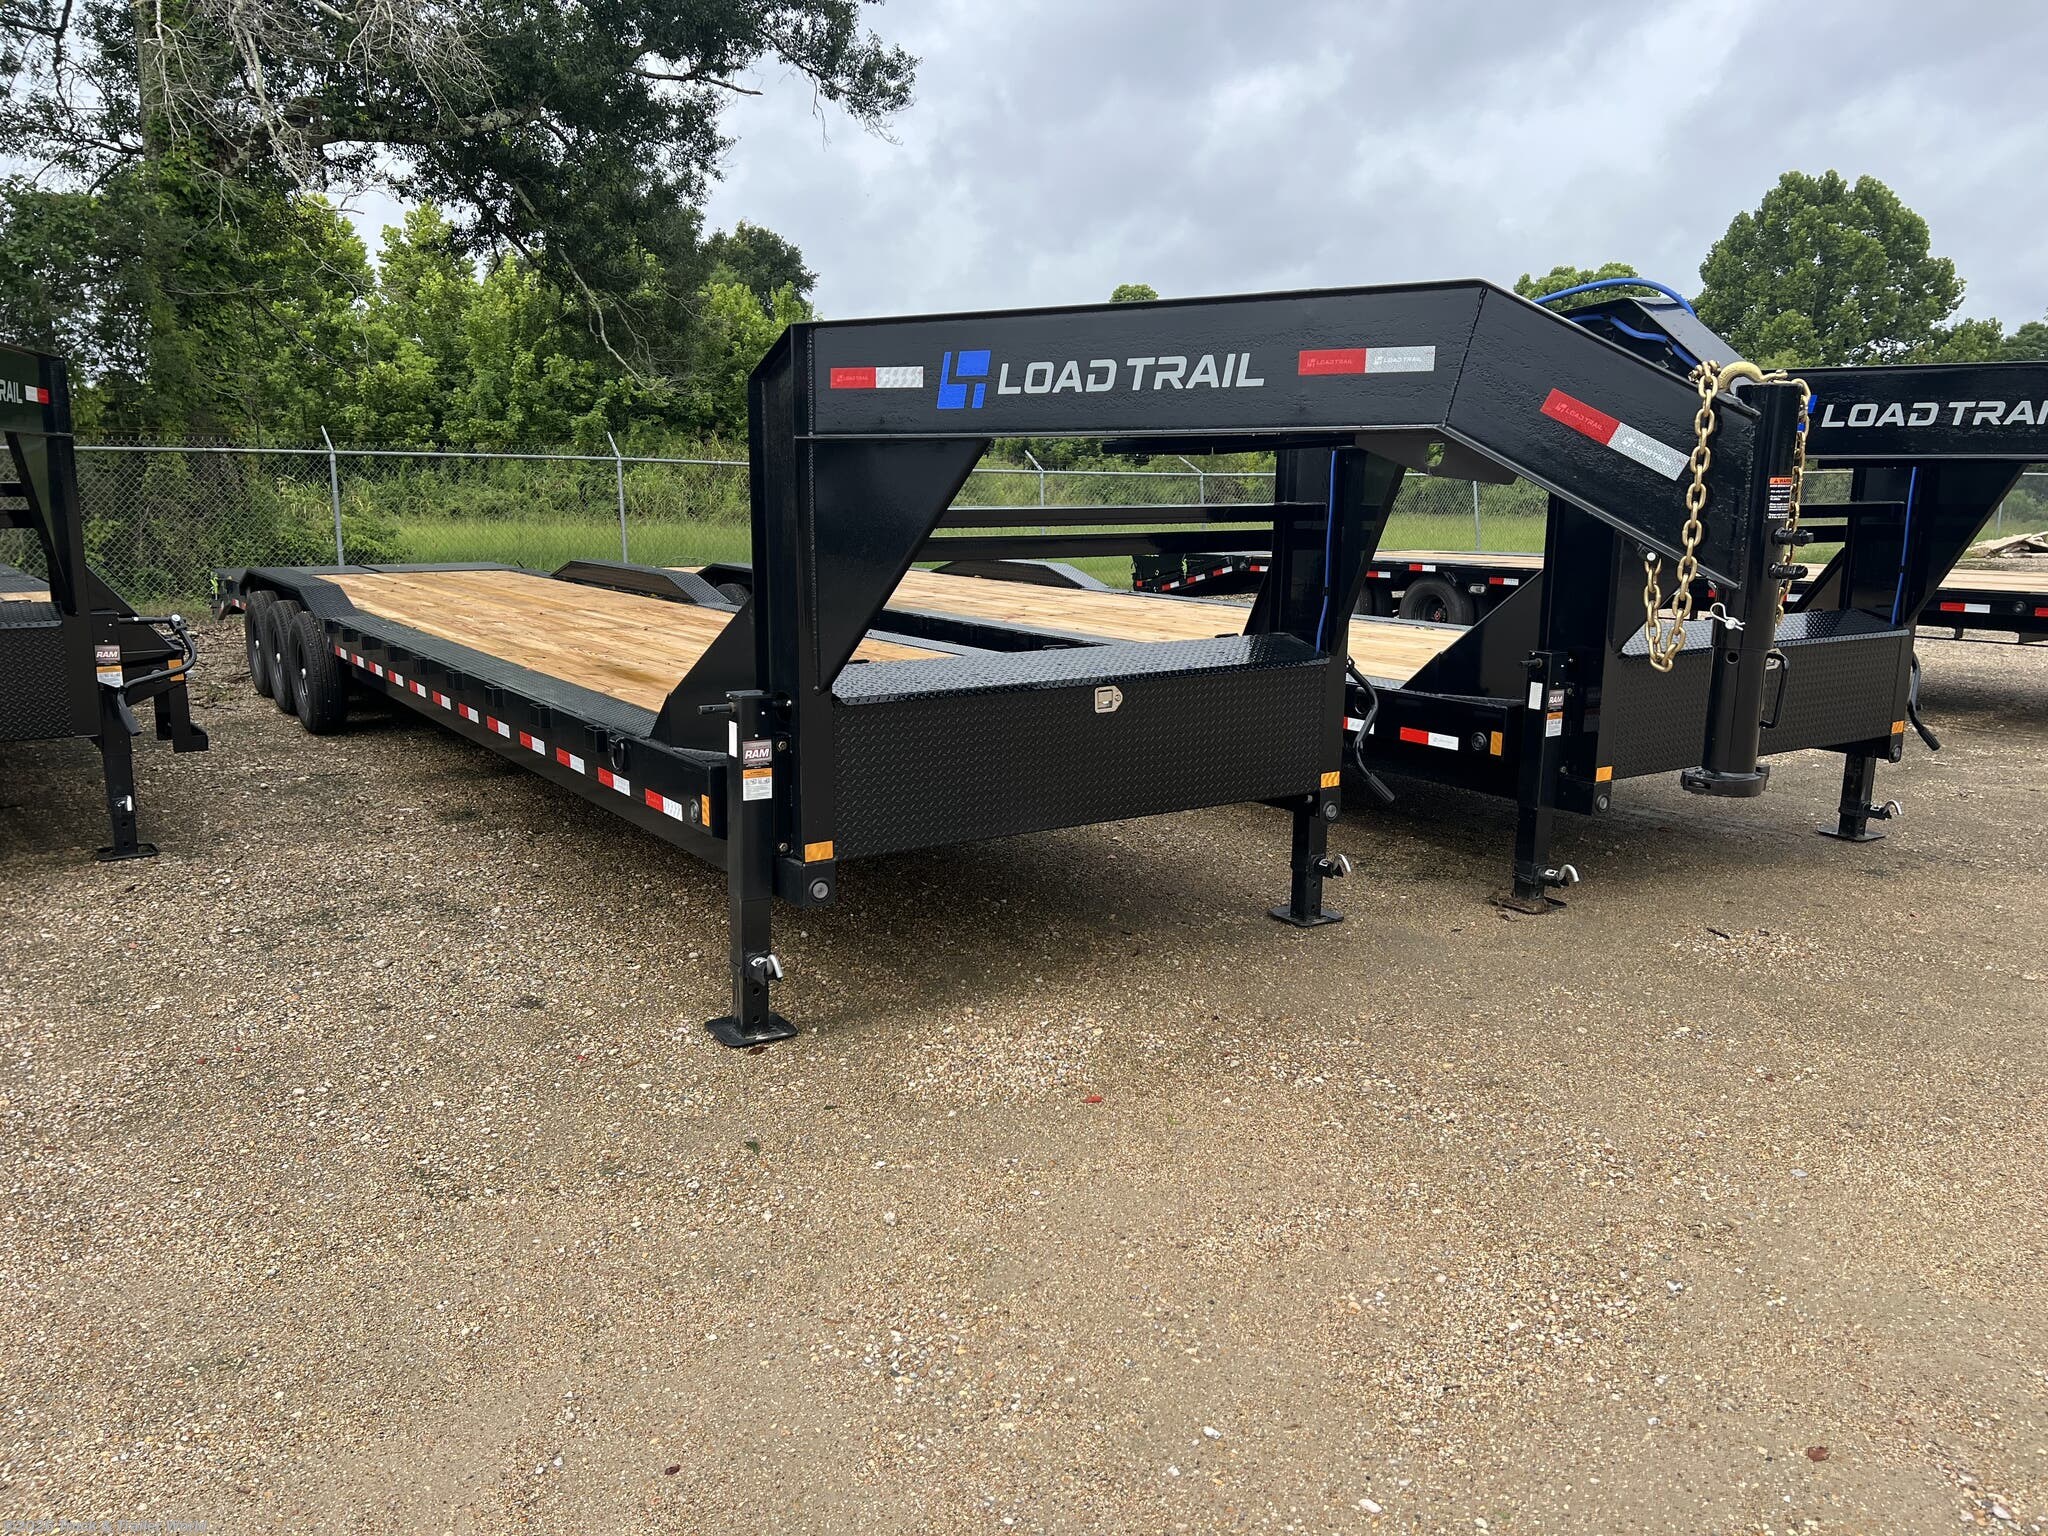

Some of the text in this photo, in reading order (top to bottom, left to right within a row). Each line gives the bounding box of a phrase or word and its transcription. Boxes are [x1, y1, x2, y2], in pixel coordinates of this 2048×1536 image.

[997, 353, 1265, 395] LOAD TRAIL
[1565, 408, 1604, 430] LOAD TRAIL
[1821, 402, 1940, 428] LOAD
[1549, 696, 1563, 704] RAM
[745, 748, 770, 760] RAM
